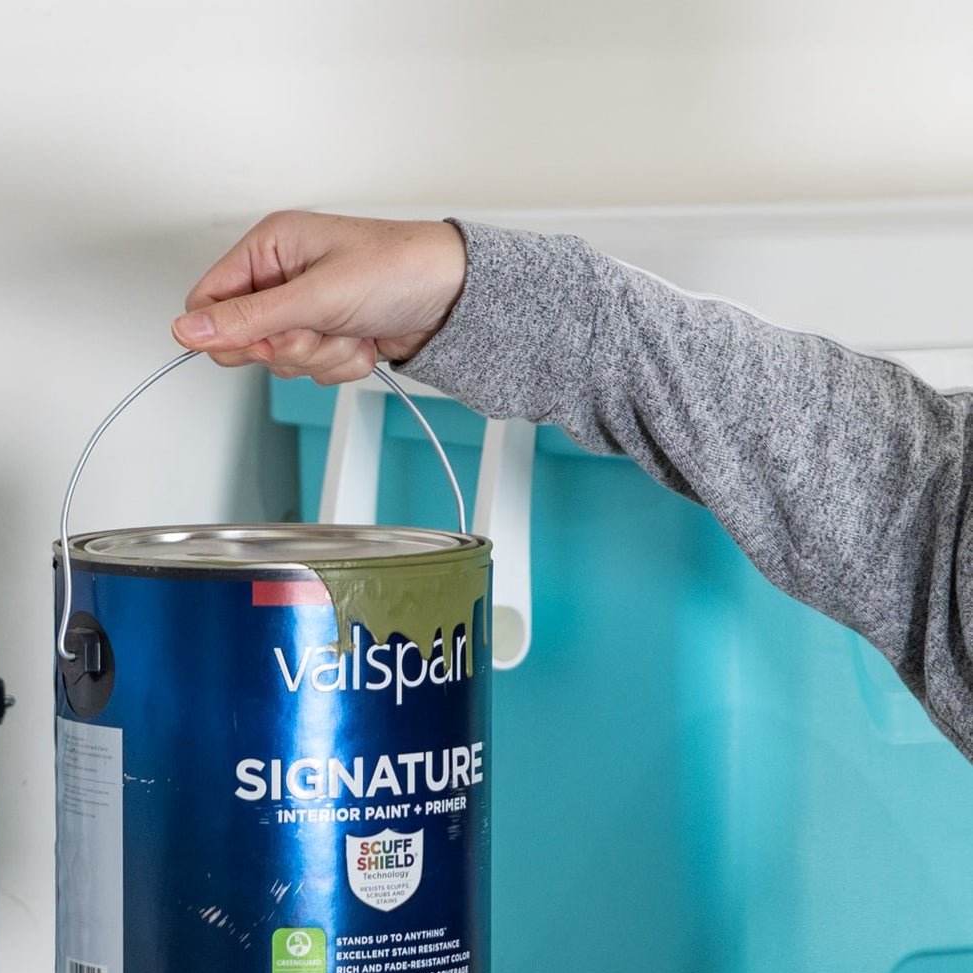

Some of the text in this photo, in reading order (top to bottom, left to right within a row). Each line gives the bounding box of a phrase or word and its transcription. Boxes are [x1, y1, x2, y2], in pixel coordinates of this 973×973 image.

[234, 741, 483, 801] SIGNATURE
[277, 796, 467, 824] INTERIOR PAINT + PRIMER
[359, 838, 413, 856] SCUFF
[357, 853, 415, 871] SHIELD
[363, 870, 409, 880] Technology
[360, 884, 385, 892] RESISTS
[336, 935, 374, 946] STANDS
[375, 933, 388, 944] UP
[390, 932, 403, 942] TO
[336, 939, 460, 961] EXCELLENT STAIN RESISTANCE
[361, 962, 383, 973] AND
[384, 955, 450, 971] FADE-RESISTANT
[451, 950, 470, 963] COLOR
